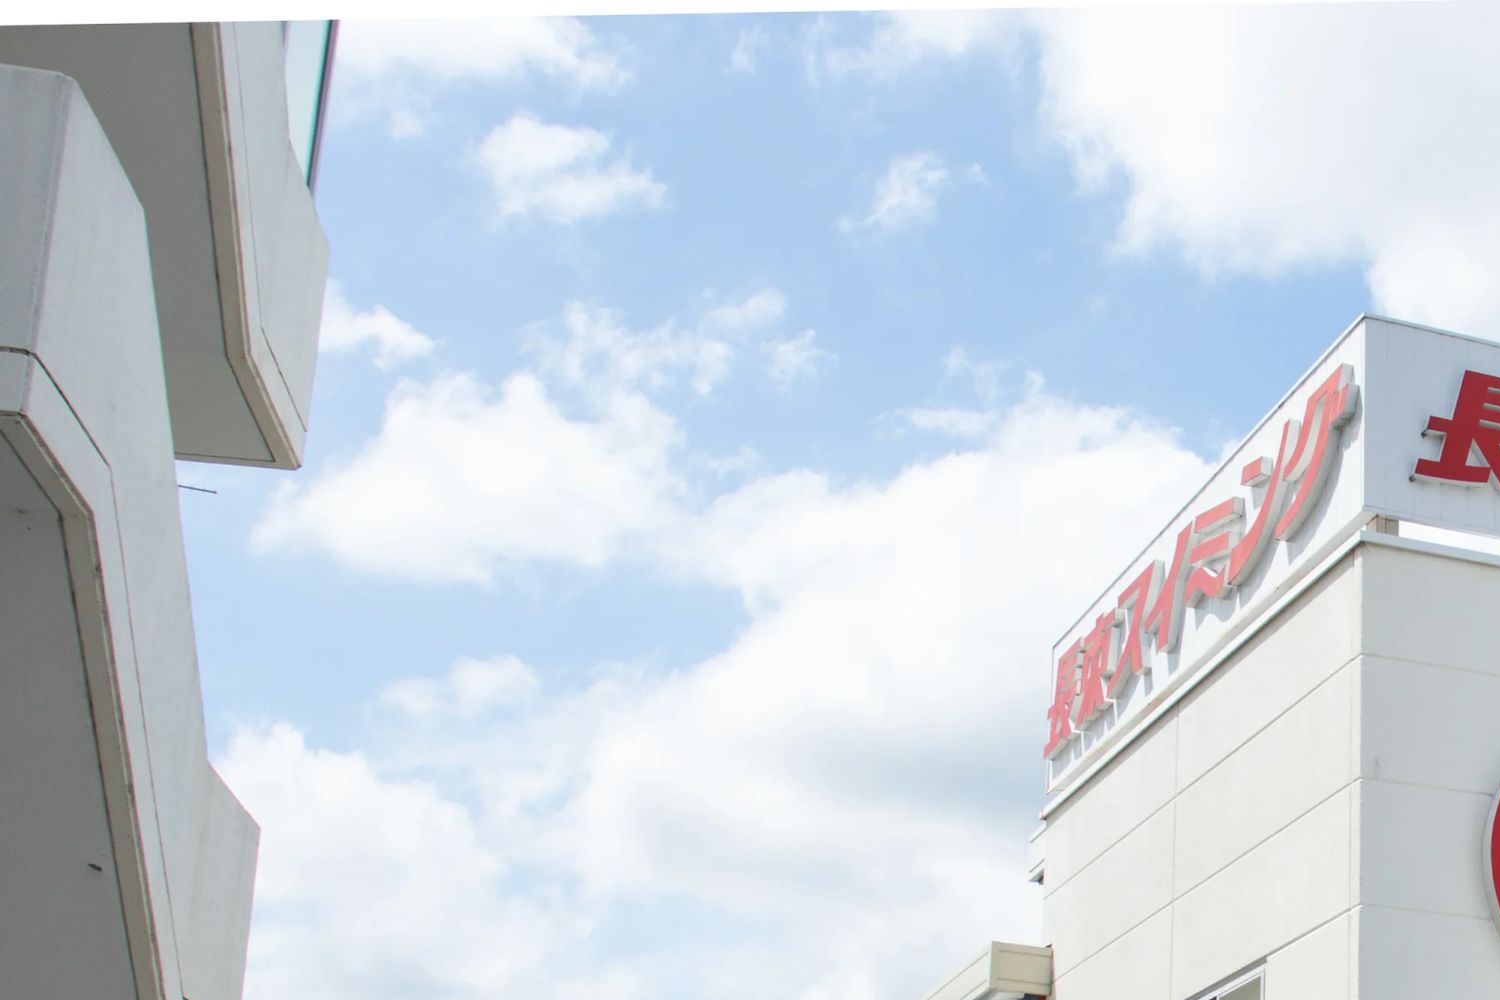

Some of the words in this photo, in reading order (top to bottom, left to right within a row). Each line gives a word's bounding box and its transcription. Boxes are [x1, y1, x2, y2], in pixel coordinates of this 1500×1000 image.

[1044, 364, 1356, 758] 長束スイミング
